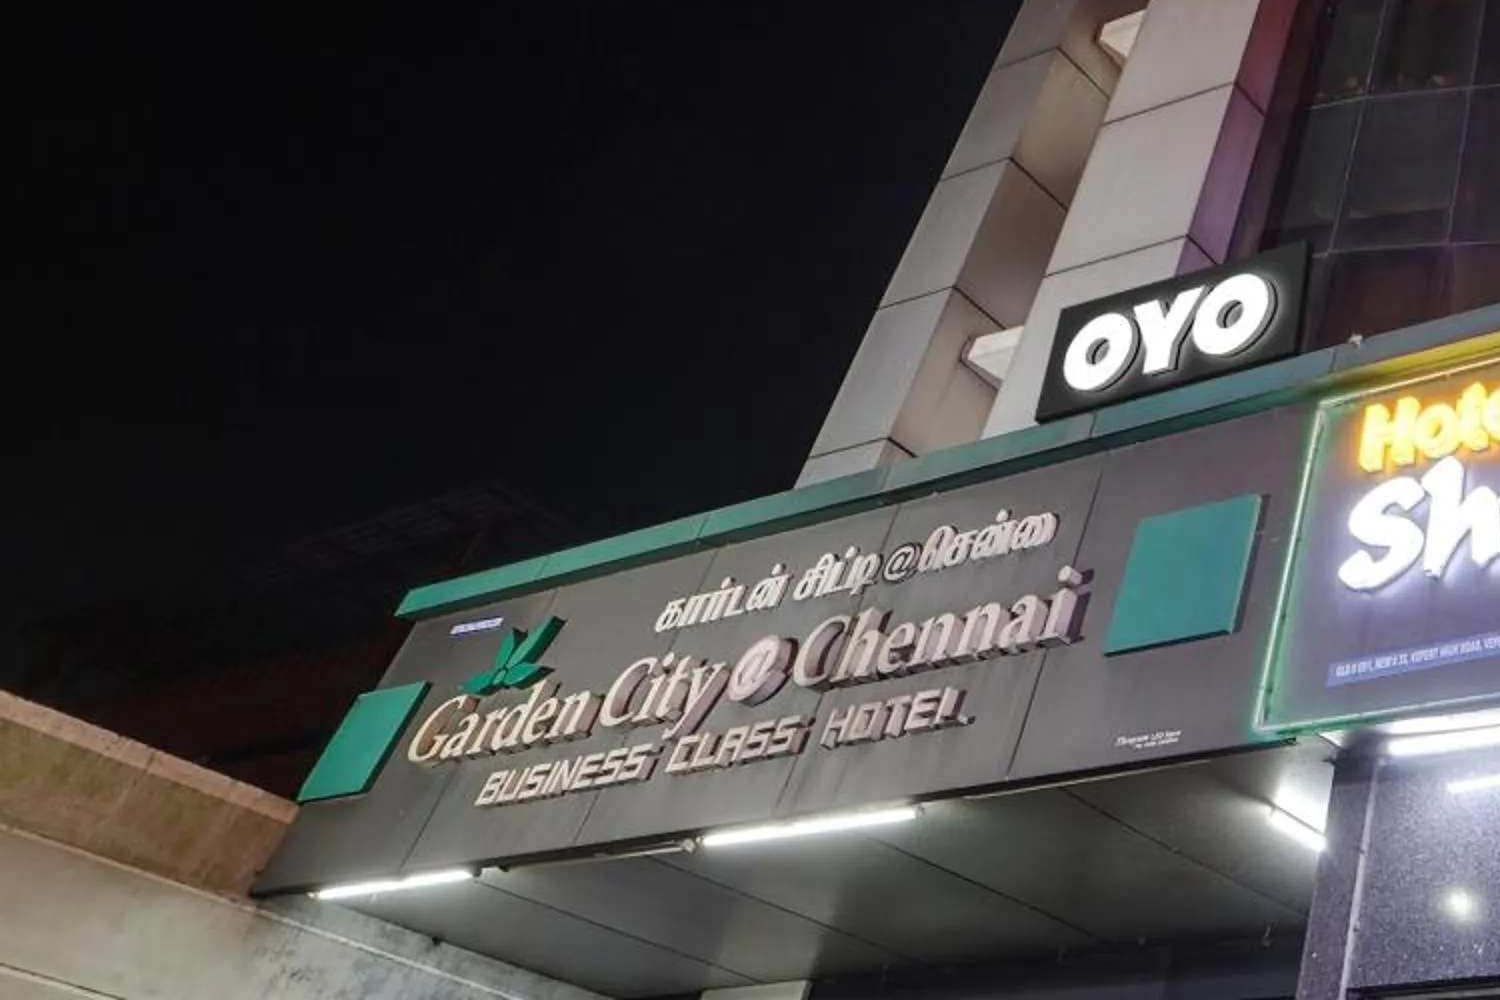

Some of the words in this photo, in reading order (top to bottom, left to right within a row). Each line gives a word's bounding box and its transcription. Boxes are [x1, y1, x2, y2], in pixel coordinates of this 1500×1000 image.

[1063, 273, 1279, 391] OYO
[654, 563, 793, 633] கார்டன்
[793, 546, 882, 601] சிட்டி
[407, 681, 602, 765] Garden
[474, 742, 664, 807] BUSINESS
[664, 714, 814, 774] CLASS
[819, 685, 970, 751] HOTEL
